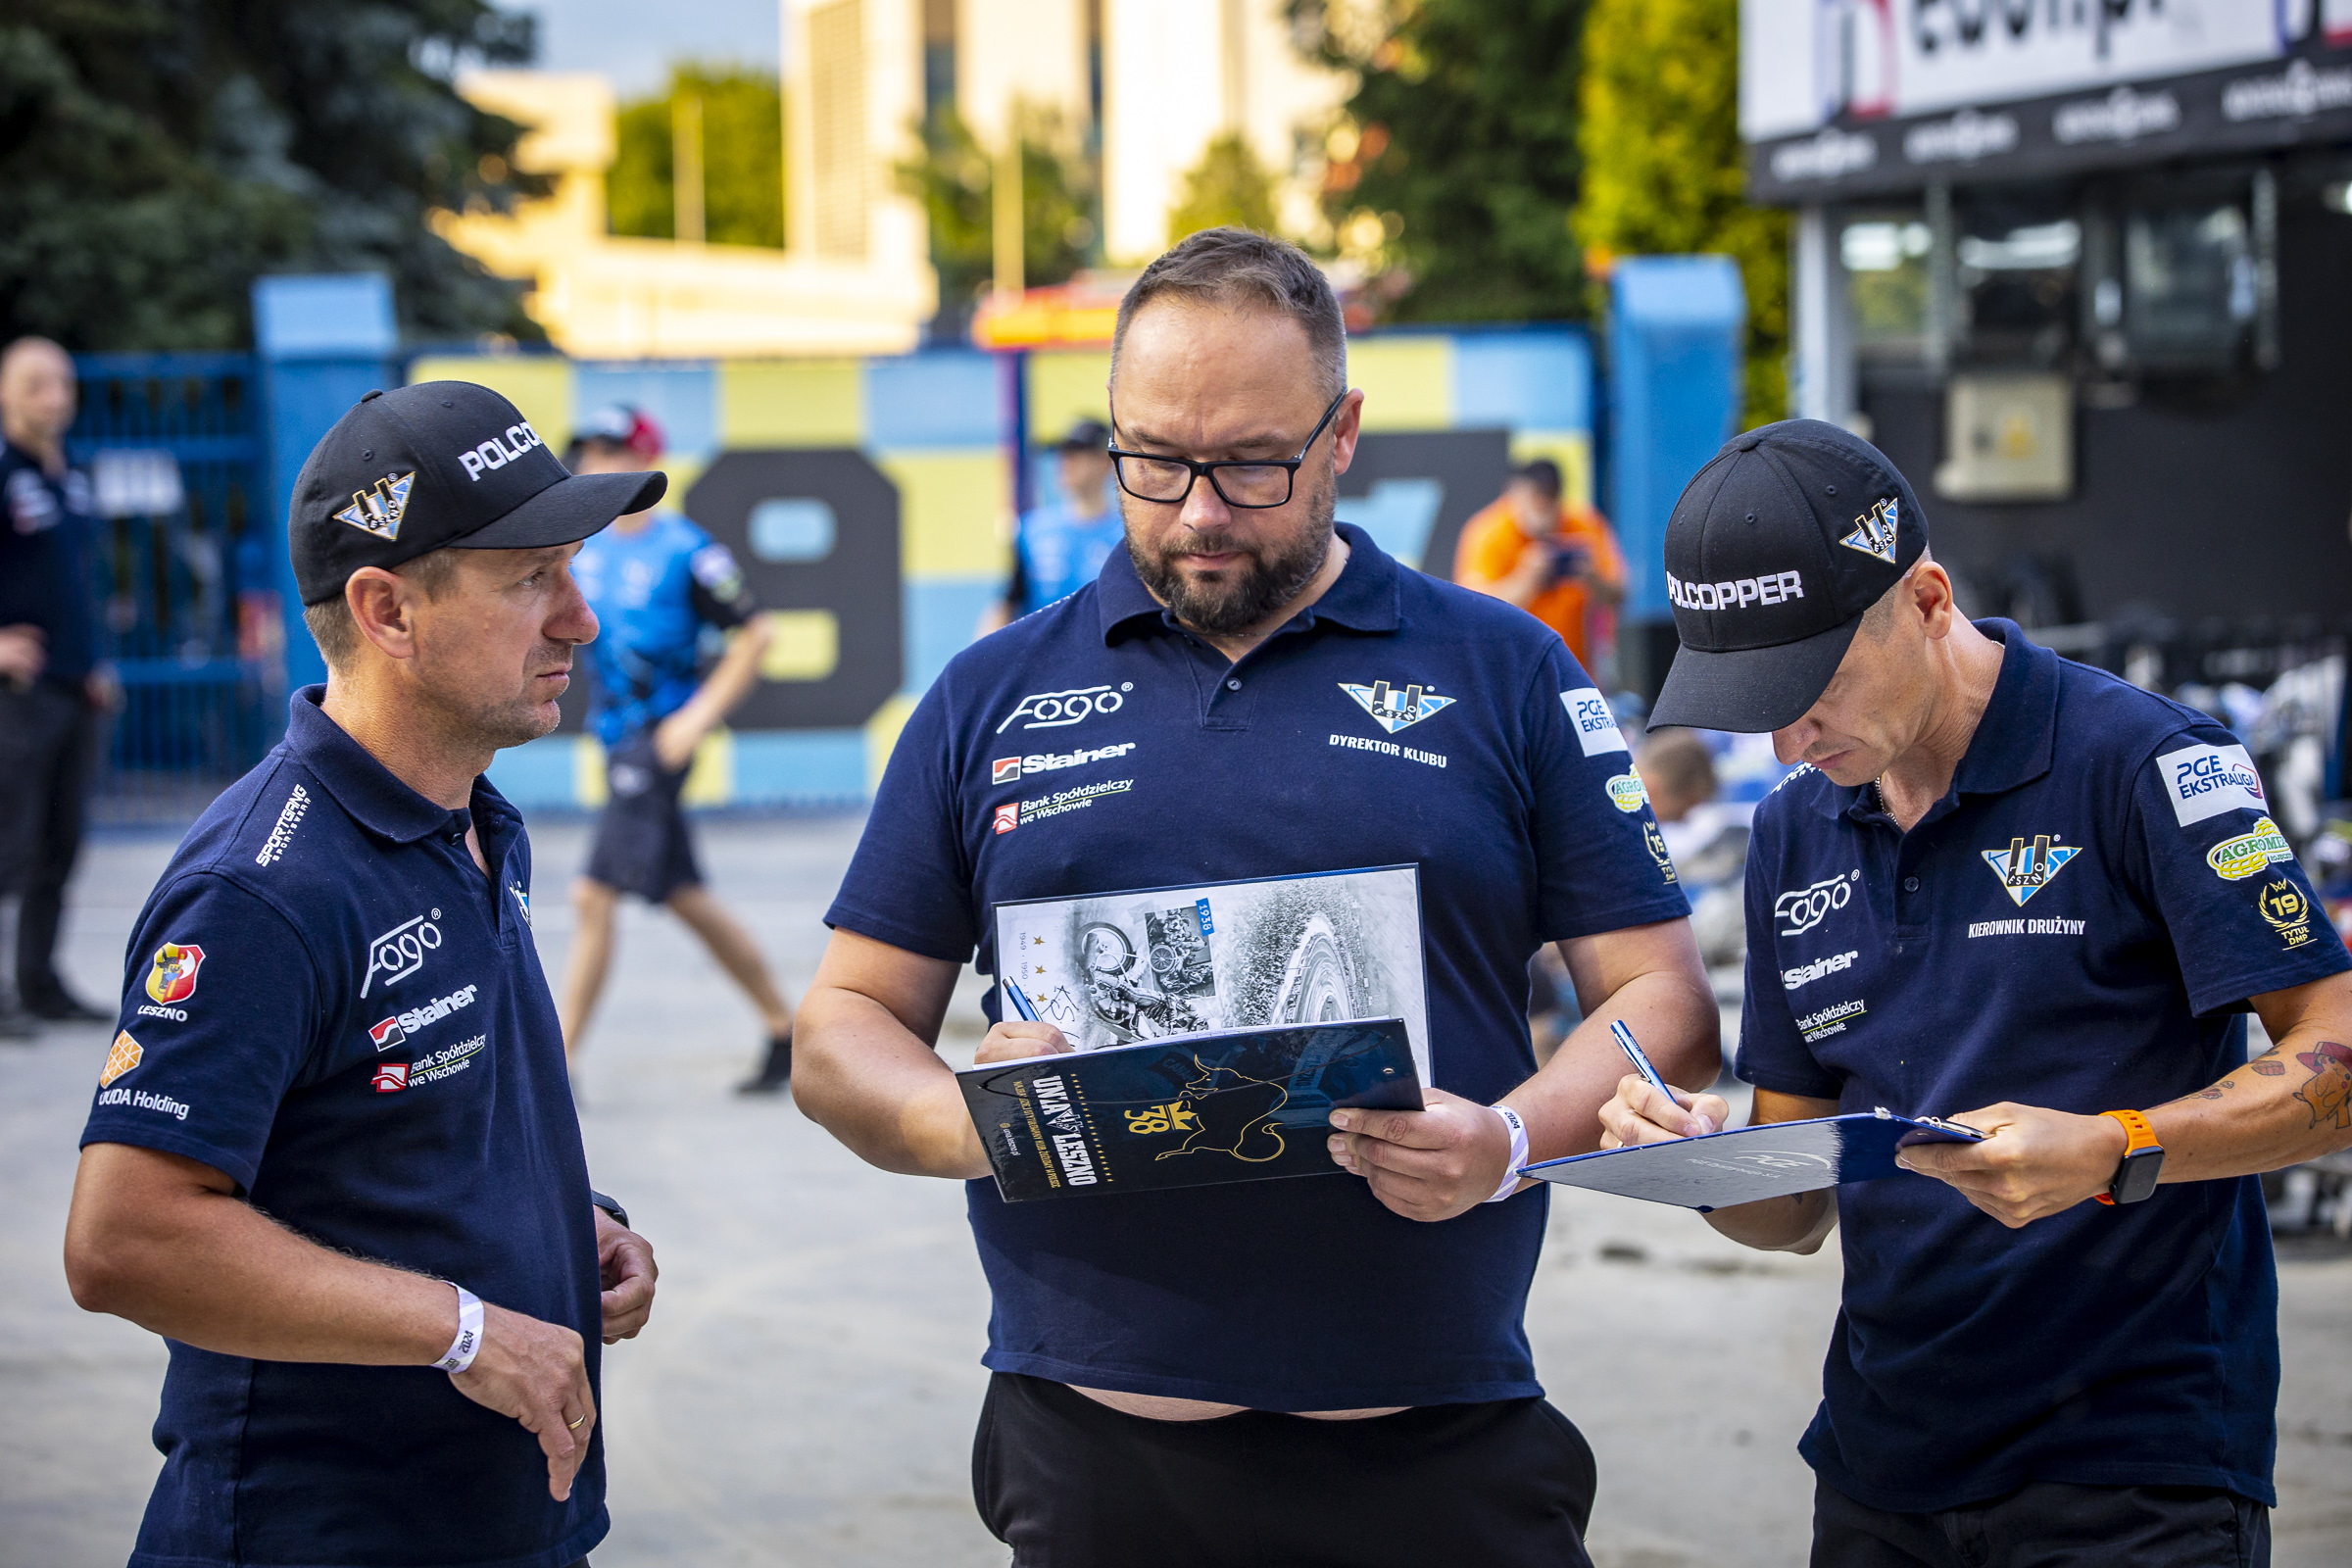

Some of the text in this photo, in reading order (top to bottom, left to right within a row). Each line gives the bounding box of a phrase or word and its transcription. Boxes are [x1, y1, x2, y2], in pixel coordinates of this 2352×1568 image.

[457, 421, 542, 481] POLCO
[1373, 700, 1417, 721] LESZNO
[1577, 699, 1605, 719] PGE
[1021, 742, 1136, 774] Stainer
[1329, 734, 1447, 768] DYREKTOR KLUBU
[2177, 755, 2223, 785] PGE
[1020, 779, 1134, 813] Bank Spółdzielczy
[2179, 773, 2254, 800] EKSTRALIGA
[255, 783, 308, 867] SPORTGANG
[1019, 798, 1092, 825] we Wschowie
[2007, 862, 2044, 885] LESZNO
[1199, 904, 1212, 931] 1938
[2270, 893, 2299, 916] 19
[1968, 915, 2086, 938] KIEROWNIK DRUŻYNY
[2288, 933, 2308, 946] DMP
[137, 1004, 188, 1022] LESZNO
[397, 983, 478, 1034] Stainer
[1813, 999, 1865, 1028] Spółdzielczy
[1812, 1021, 1847, 1042] Wschowie
[410, 1033, 487, 1074] Bank Spółdzielczy
[409, 1057, 470, 1088] we Wschowie
[132, 1090, 190, 1121] Holding
[1124, 1104, 1170, 1135] 38
[1032, 1075, 1071, 1115] UNIA
[1052, 1132, 1098, 1186] LESZNO
